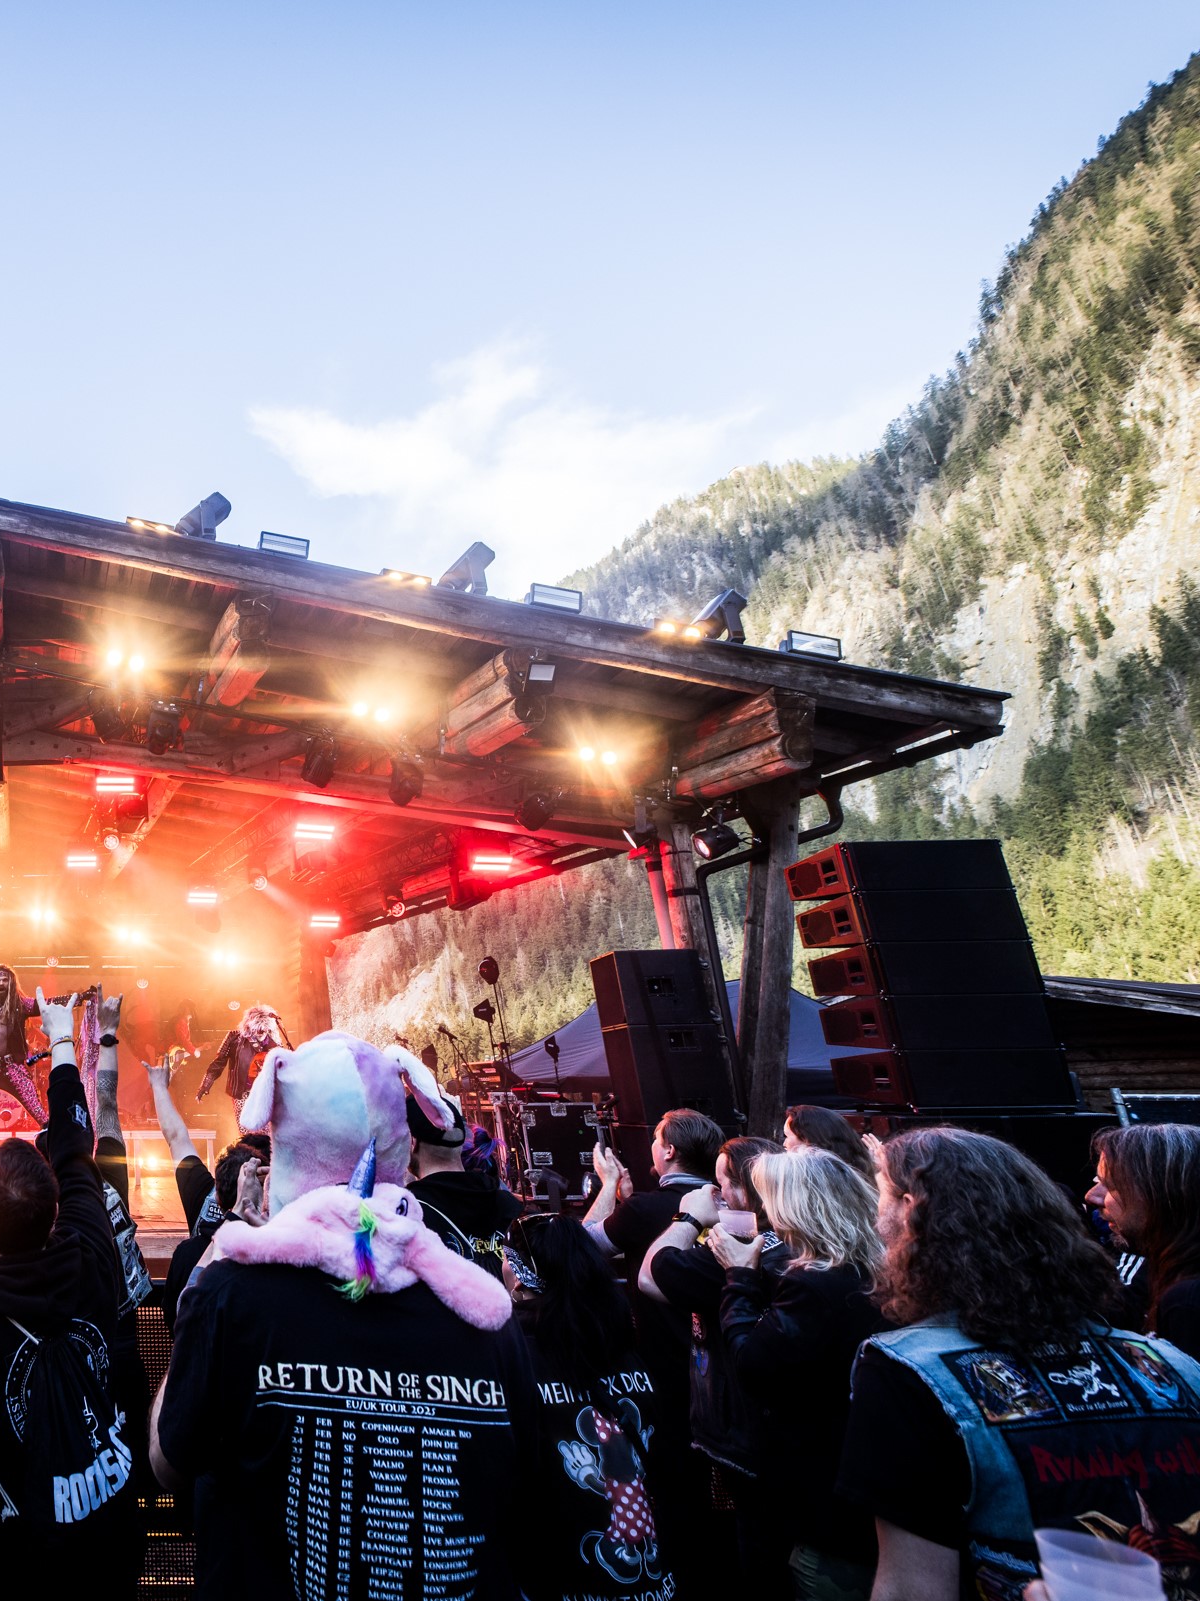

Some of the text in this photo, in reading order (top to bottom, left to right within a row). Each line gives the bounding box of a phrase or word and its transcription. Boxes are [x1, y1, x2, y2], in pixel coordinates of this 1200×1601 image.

[257, 1362, 506, 1407] RETURN OF THE SINGH
[345, 1400, 436, 1417] EU/UK TOUR 2025
[315, 1428, 332, 1438] FEB
[342, 1432, 356, 1441] NO
[377, 1434, 400, 1445] OSLO
[421, 1438, 442, 1449] JOHN
[316, 1417, 332, 1427] FEB
[343, 1420, 356, 1429] DK
[361, 1421, 415, 1434] COPENHAGEN
[421, 1426, 456, 1438] AMAGER
[314, 1440, 331, 1450] FEB
[343, 1444, 354, 1453] SE
[362, 1445, 414, 1458] STOCKHOLM
[422, 1450, 458, 1462] DEBASER
[314, 1450, 331, 1461] FEB
[343, 1456, 354, 1465] SE
[422, 1462, 445, 1473] PLAN
[343, 1468, 353, 1477] PL
[369, 1470, 408, 1482] WARSAW
[422, 1474, 460, 1486] PROXIMA
[308, 1482, 331, 1497] MAR
[341, 1491, 353, 1501] DE
[366, 1493, 410, 1507] HAMBURG
[422, 1498, 452, 1511] DOCKS
[341, 1479, 353, 1489] DE
[374, 1482, 403, 1494] BERLIN
[422, 1486, 460, 1498] HUXLEYS
[307, 1493, 331, 1509] MAR
[341, 1502, 353, 1512] NL
[360, 1504, 415, 1519] AMSTERDAM
[423, 1510, 465, 1523] MELKWEG
[307, 1503, 330, 1520] MAR
[366, 1517, 410, 1531] ANTWERP
[423, 1522, 444, 1535] TRIX
[306, 1514, 330, 1531] MAR
[340, 1525, 352, 1536] DE
[366, 1529, 409, 1544] COLOGNE
[423, 1535, 443, 1546] LIVE
[306, 1526, 329, 1543] MAR
[339, 1537, 351, 1548] DE
[361, 1540, 414, 1556] FRANKFURT
[306, 1536, 328, 1554] MAR
[338, 1548, 351, 1559] DE
[360, 1552, 414, 1569] STUTTGART
[338, 1560, 350, 1571] DE
[370, 1565, 404, 1580] LEIPZIG
[336, 1583, 349, 1595] DE
[368, 1577, 404, 1591] PRAGUE
[423, 1584, 447, 1595] ROXY
